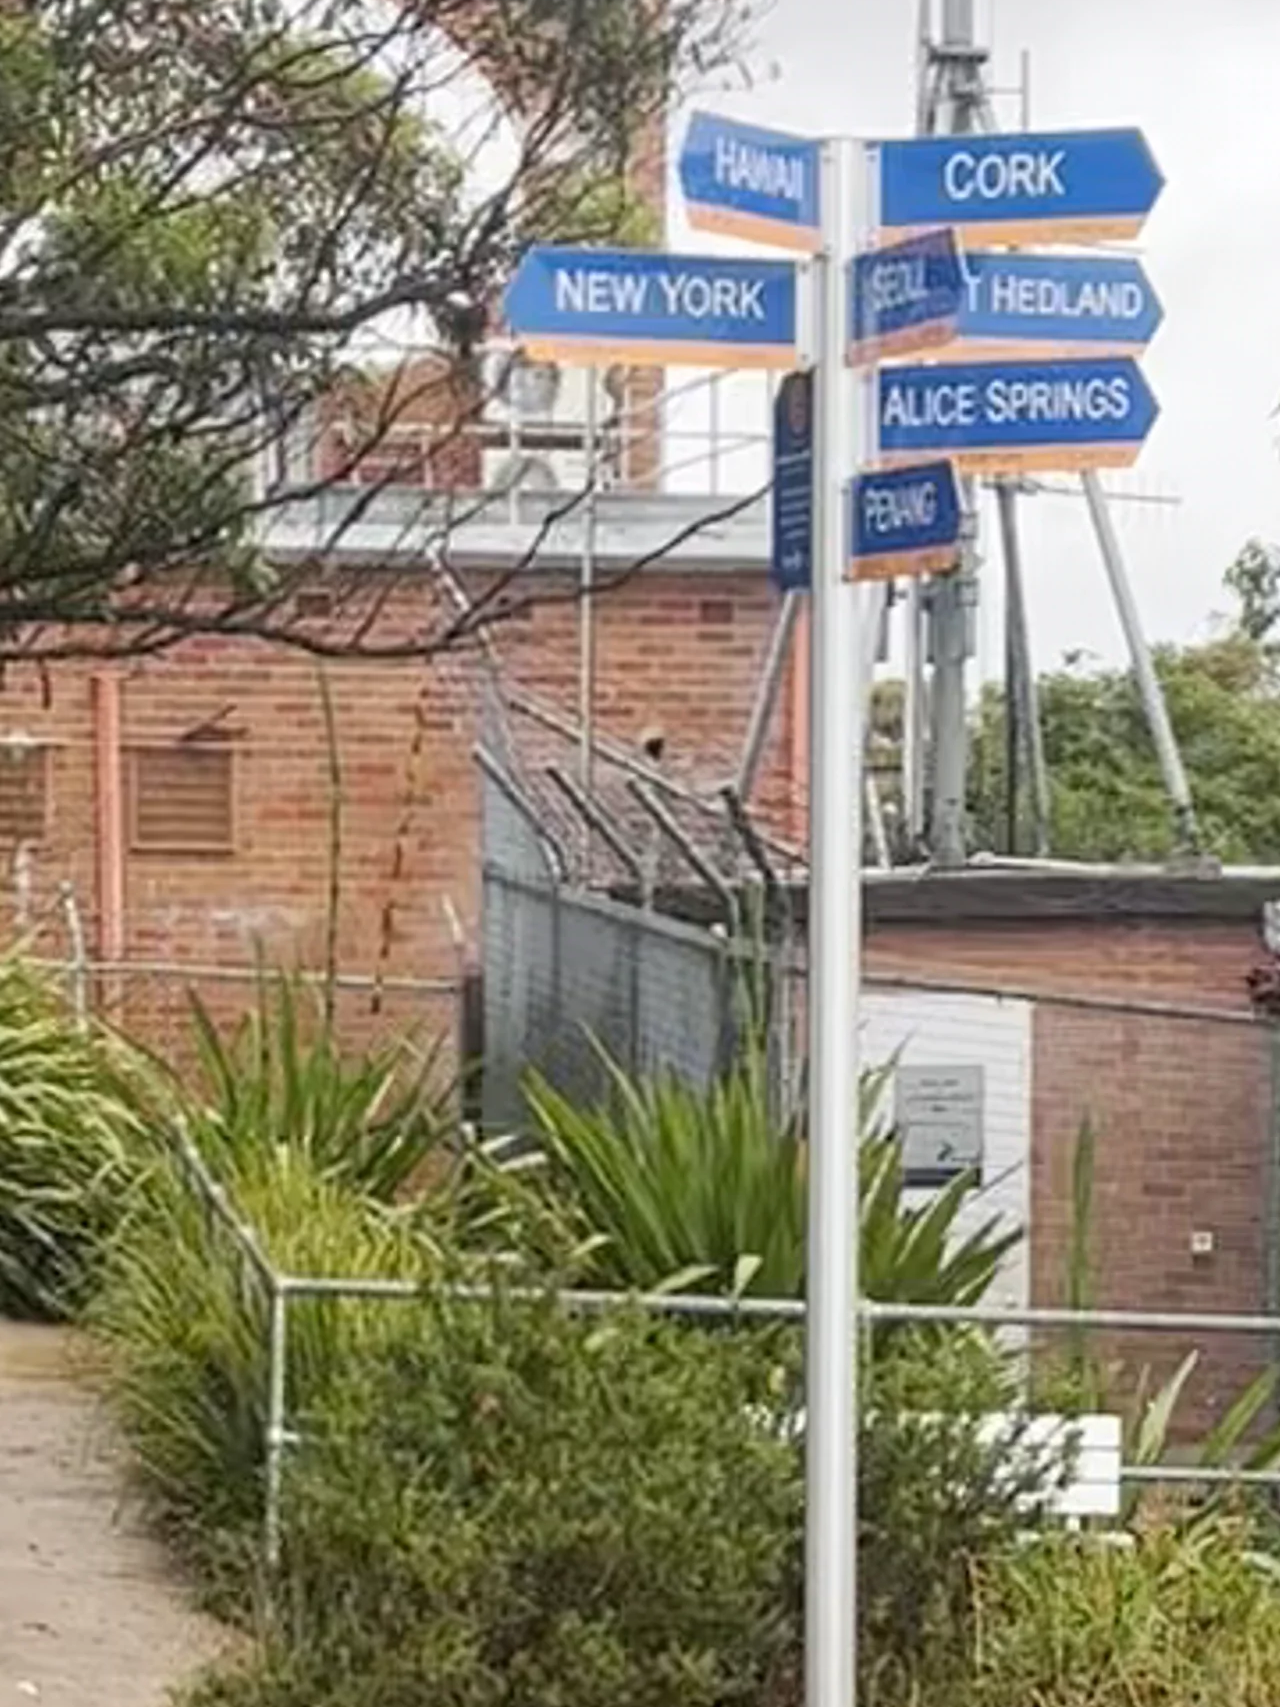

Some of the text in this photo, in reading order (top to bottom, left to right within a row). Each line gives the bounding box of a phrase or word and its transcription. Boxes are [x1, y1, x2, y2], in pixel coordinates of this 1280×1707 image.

[716, 136, 803, 200] HAWAII
[944, 150, 1066, 201] CORK
[555, 268, 766, 320] NEW YORK
[991, 273, 1142, 318] HEDLAND
[882, 378, 1131, 426] ALICE SPRINGS
